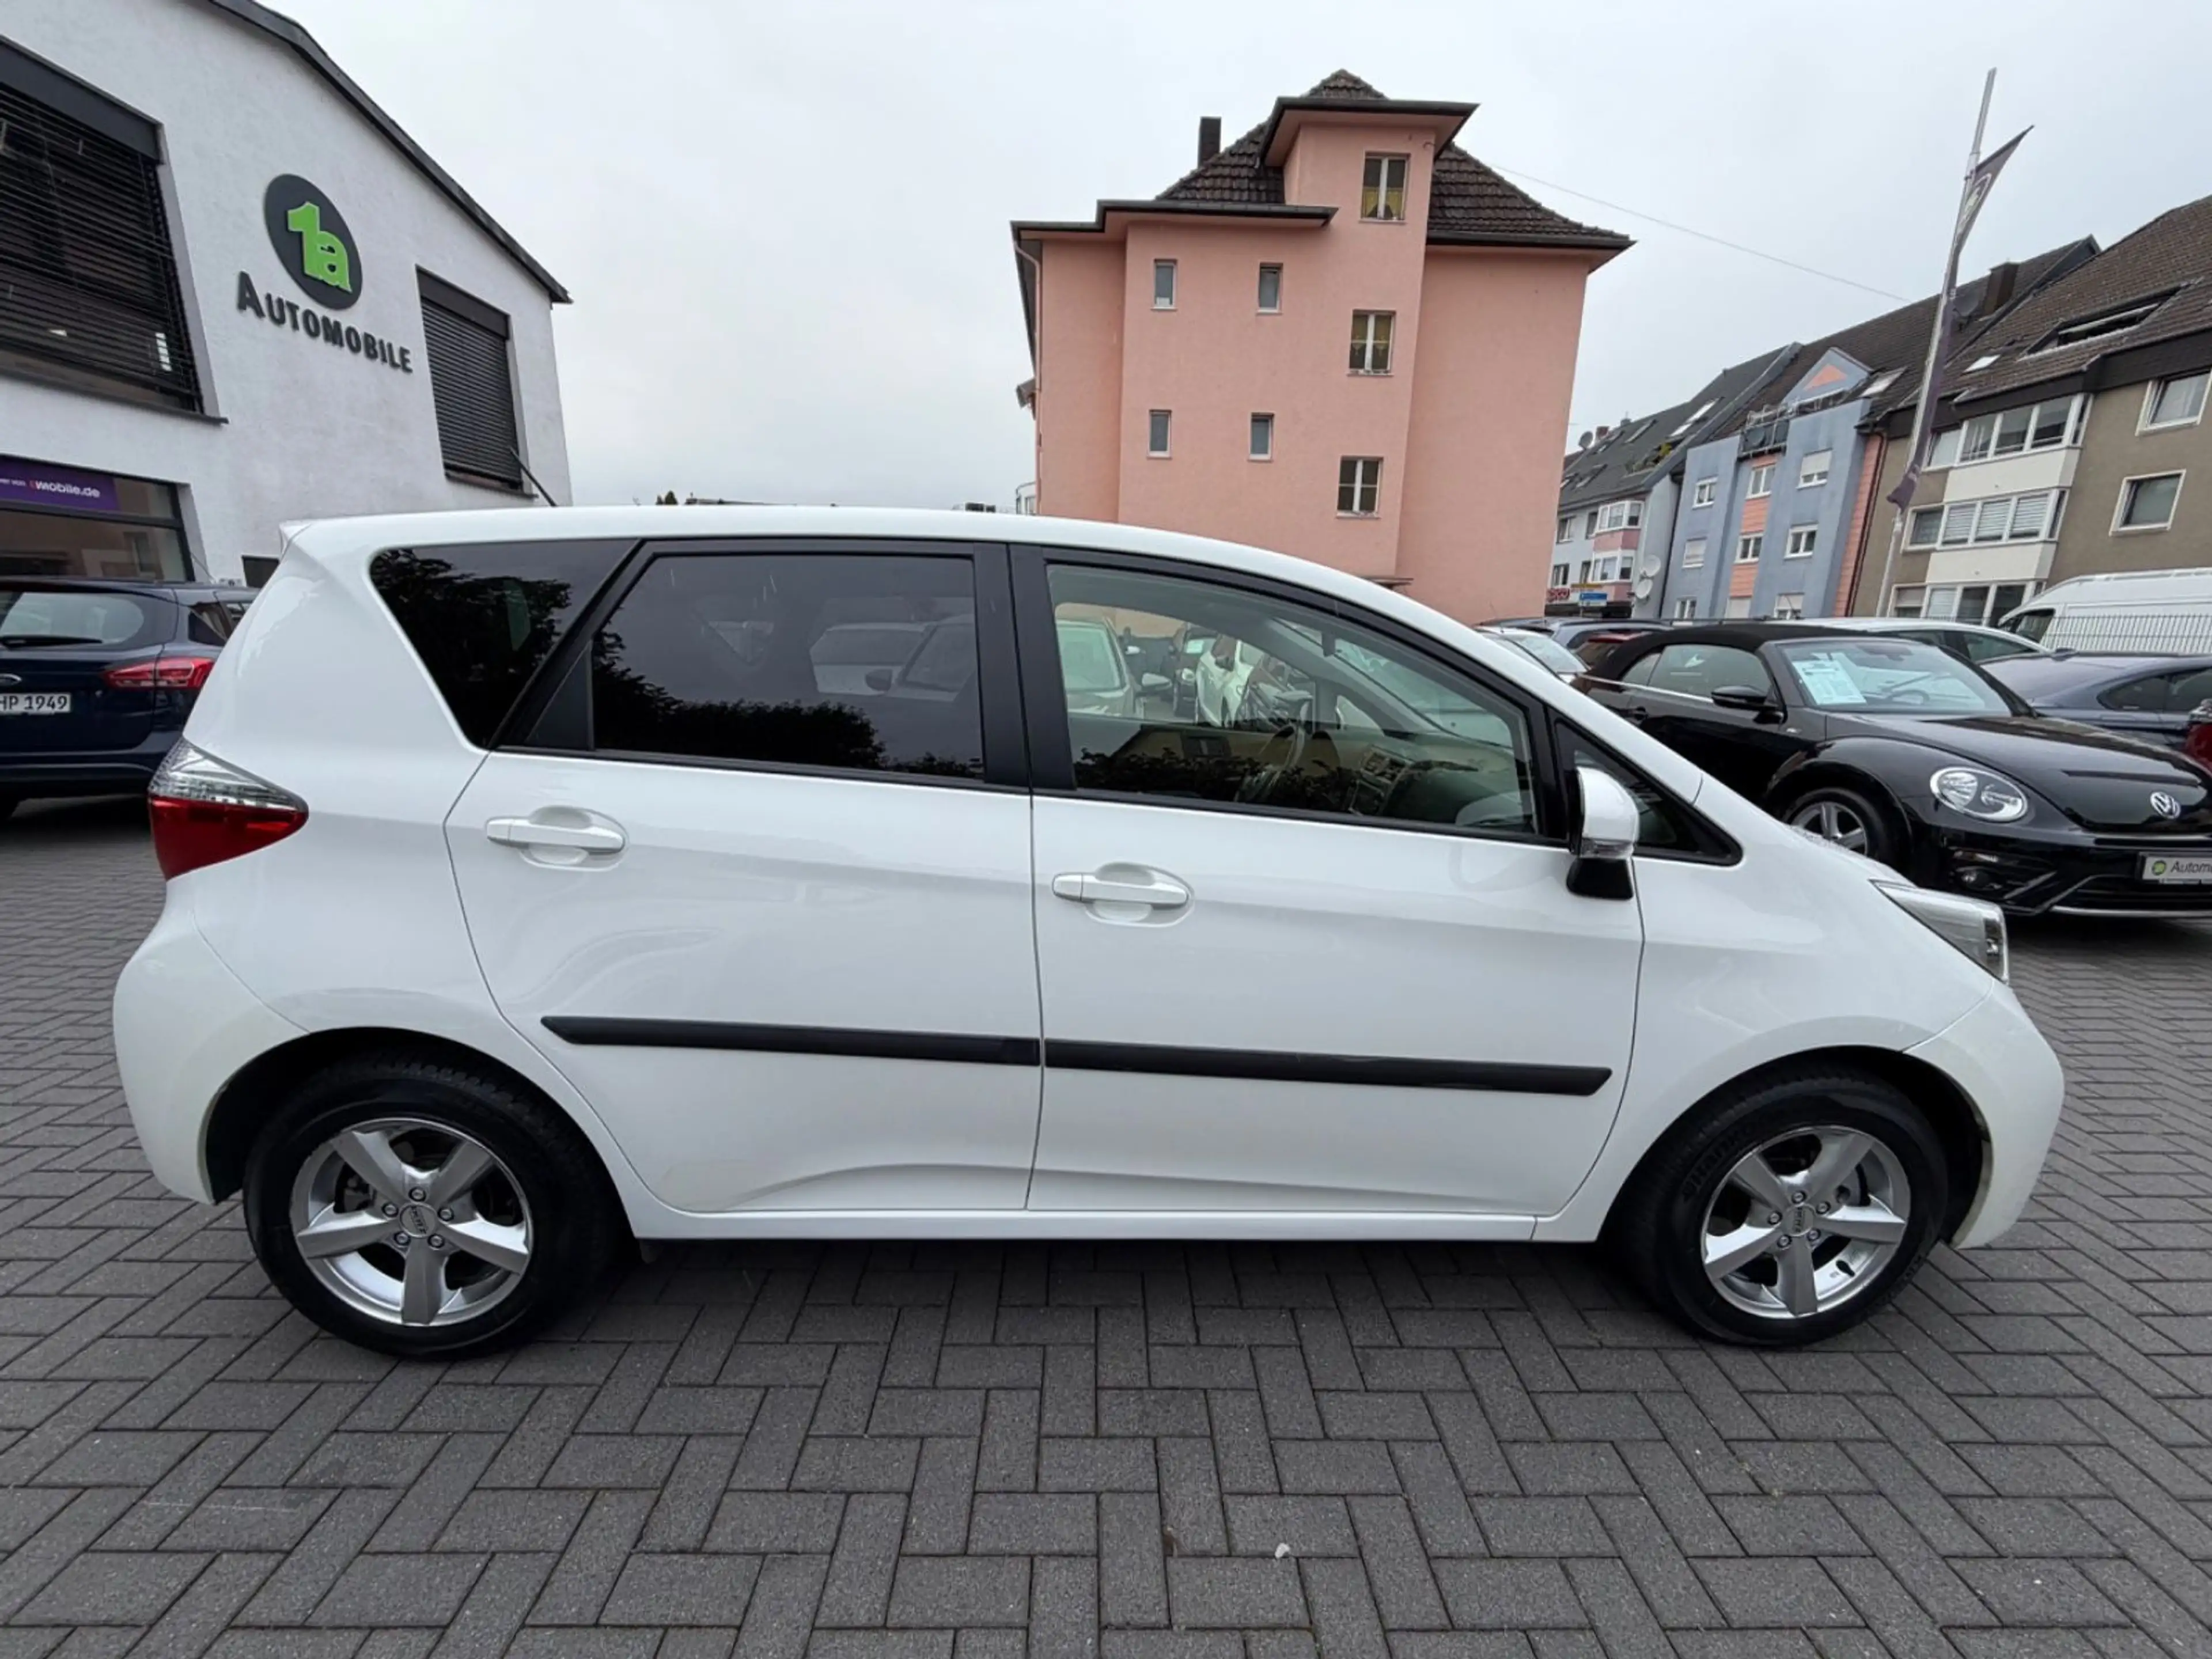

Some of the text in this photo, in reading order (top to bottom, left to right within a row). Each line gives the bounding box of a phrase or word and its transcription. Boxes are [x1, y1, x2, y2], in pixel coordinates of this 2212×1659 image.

[287, 202, 353, 294] 1a
[237, 270, 412, 373] AUTOMOBILE
[24, 695, 67, 710] 1949
[2170, 860, 2212, 874] Autom
